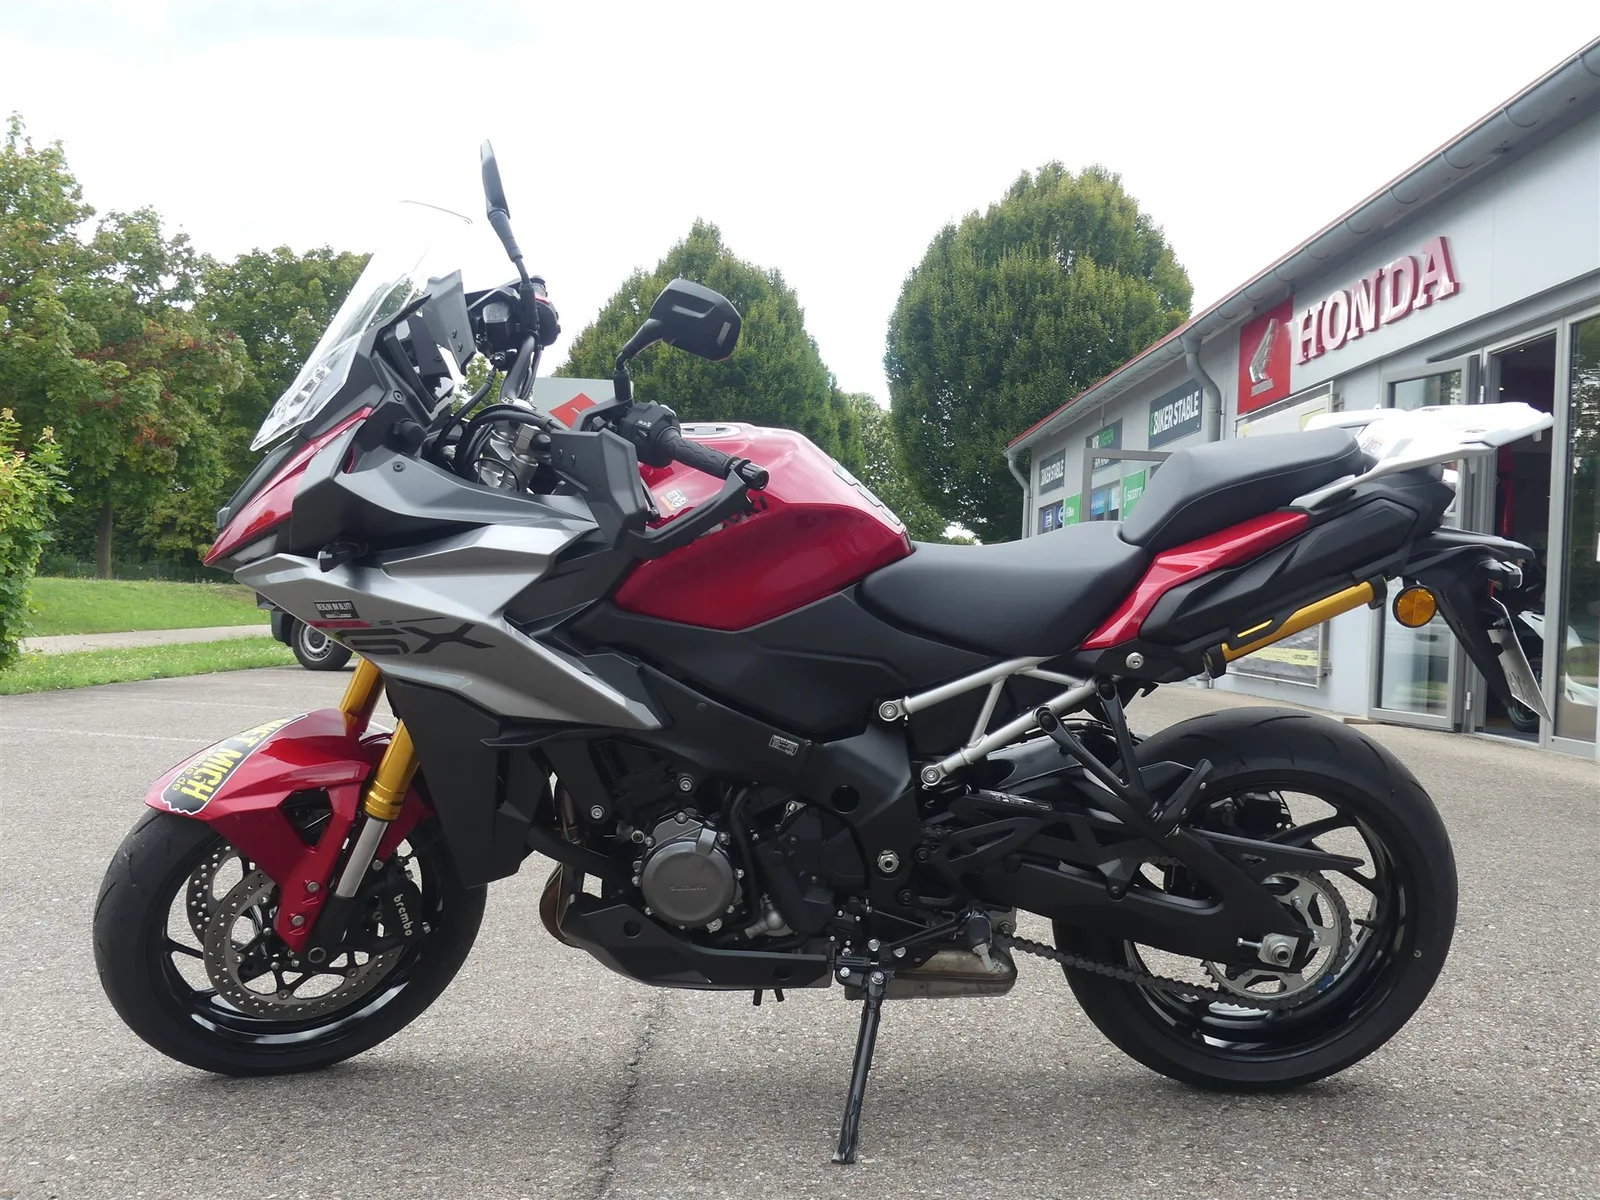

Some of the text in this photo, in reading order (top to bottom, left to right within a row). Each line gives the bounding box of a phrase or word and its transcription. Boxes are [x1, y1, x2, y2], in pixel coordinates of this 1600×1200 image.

[1295, 235, 1460, 365] HONDA
[1173, 390, 1199, 425] STABLE
[180, 747, 244, 802] MICH
[393, 893, 414, 937] brembo
